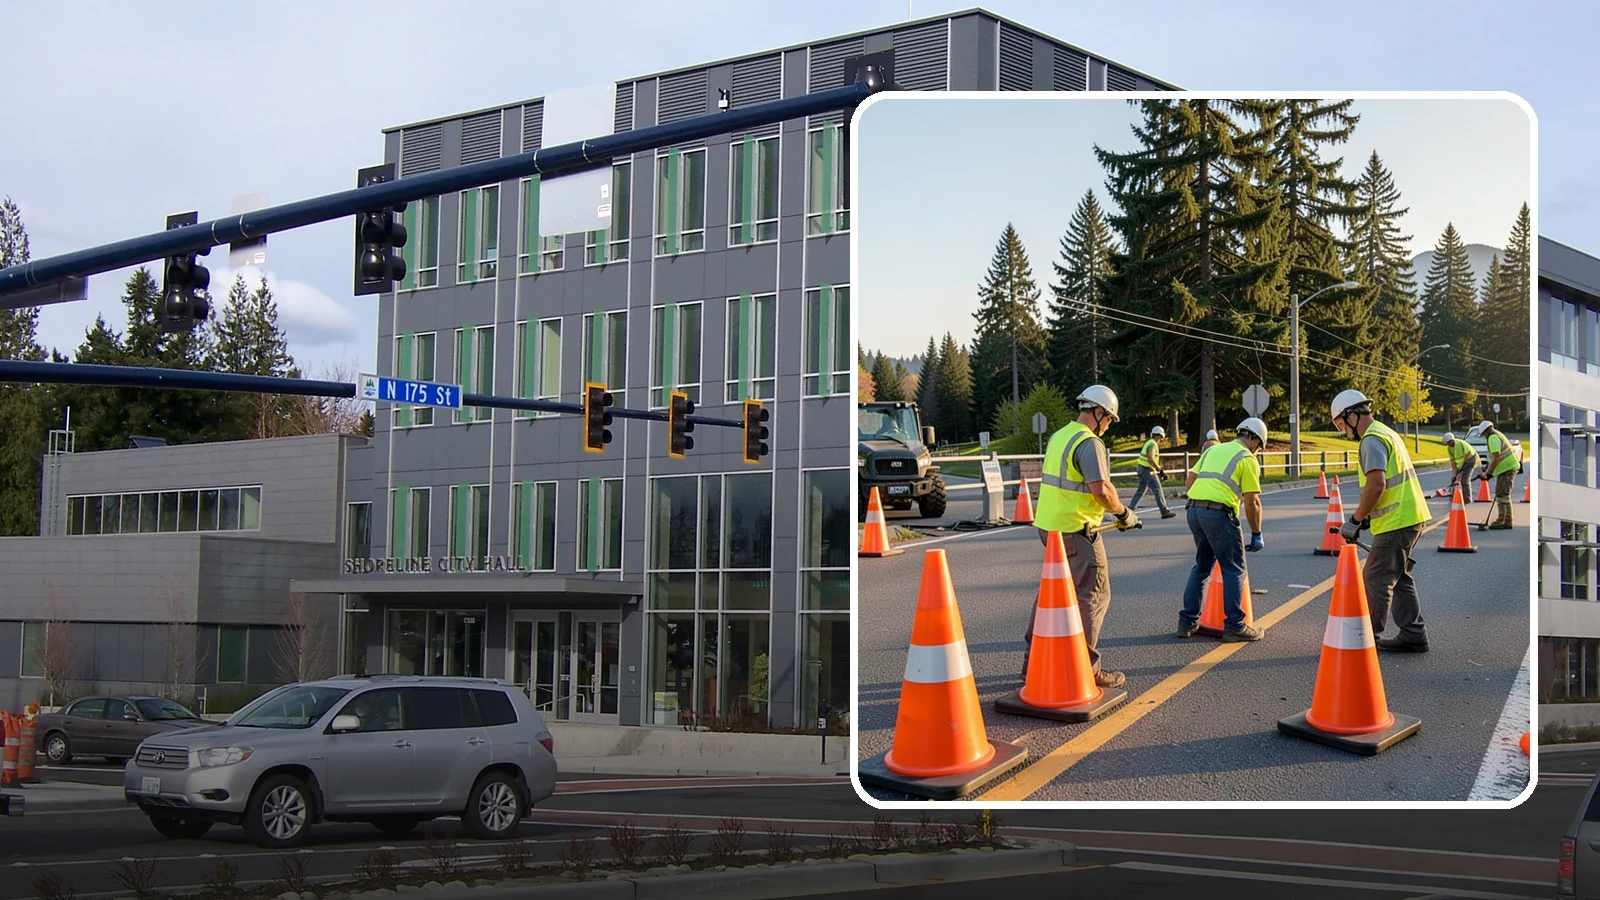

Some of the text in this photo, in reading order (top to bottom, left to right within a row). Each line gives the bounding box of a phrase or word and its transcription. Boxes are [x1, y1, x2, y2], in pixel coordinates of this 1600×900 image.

[387, 380, 452, 406] N 175 St
[344, 555, 526, 574] SHORELINE CITY HALL
